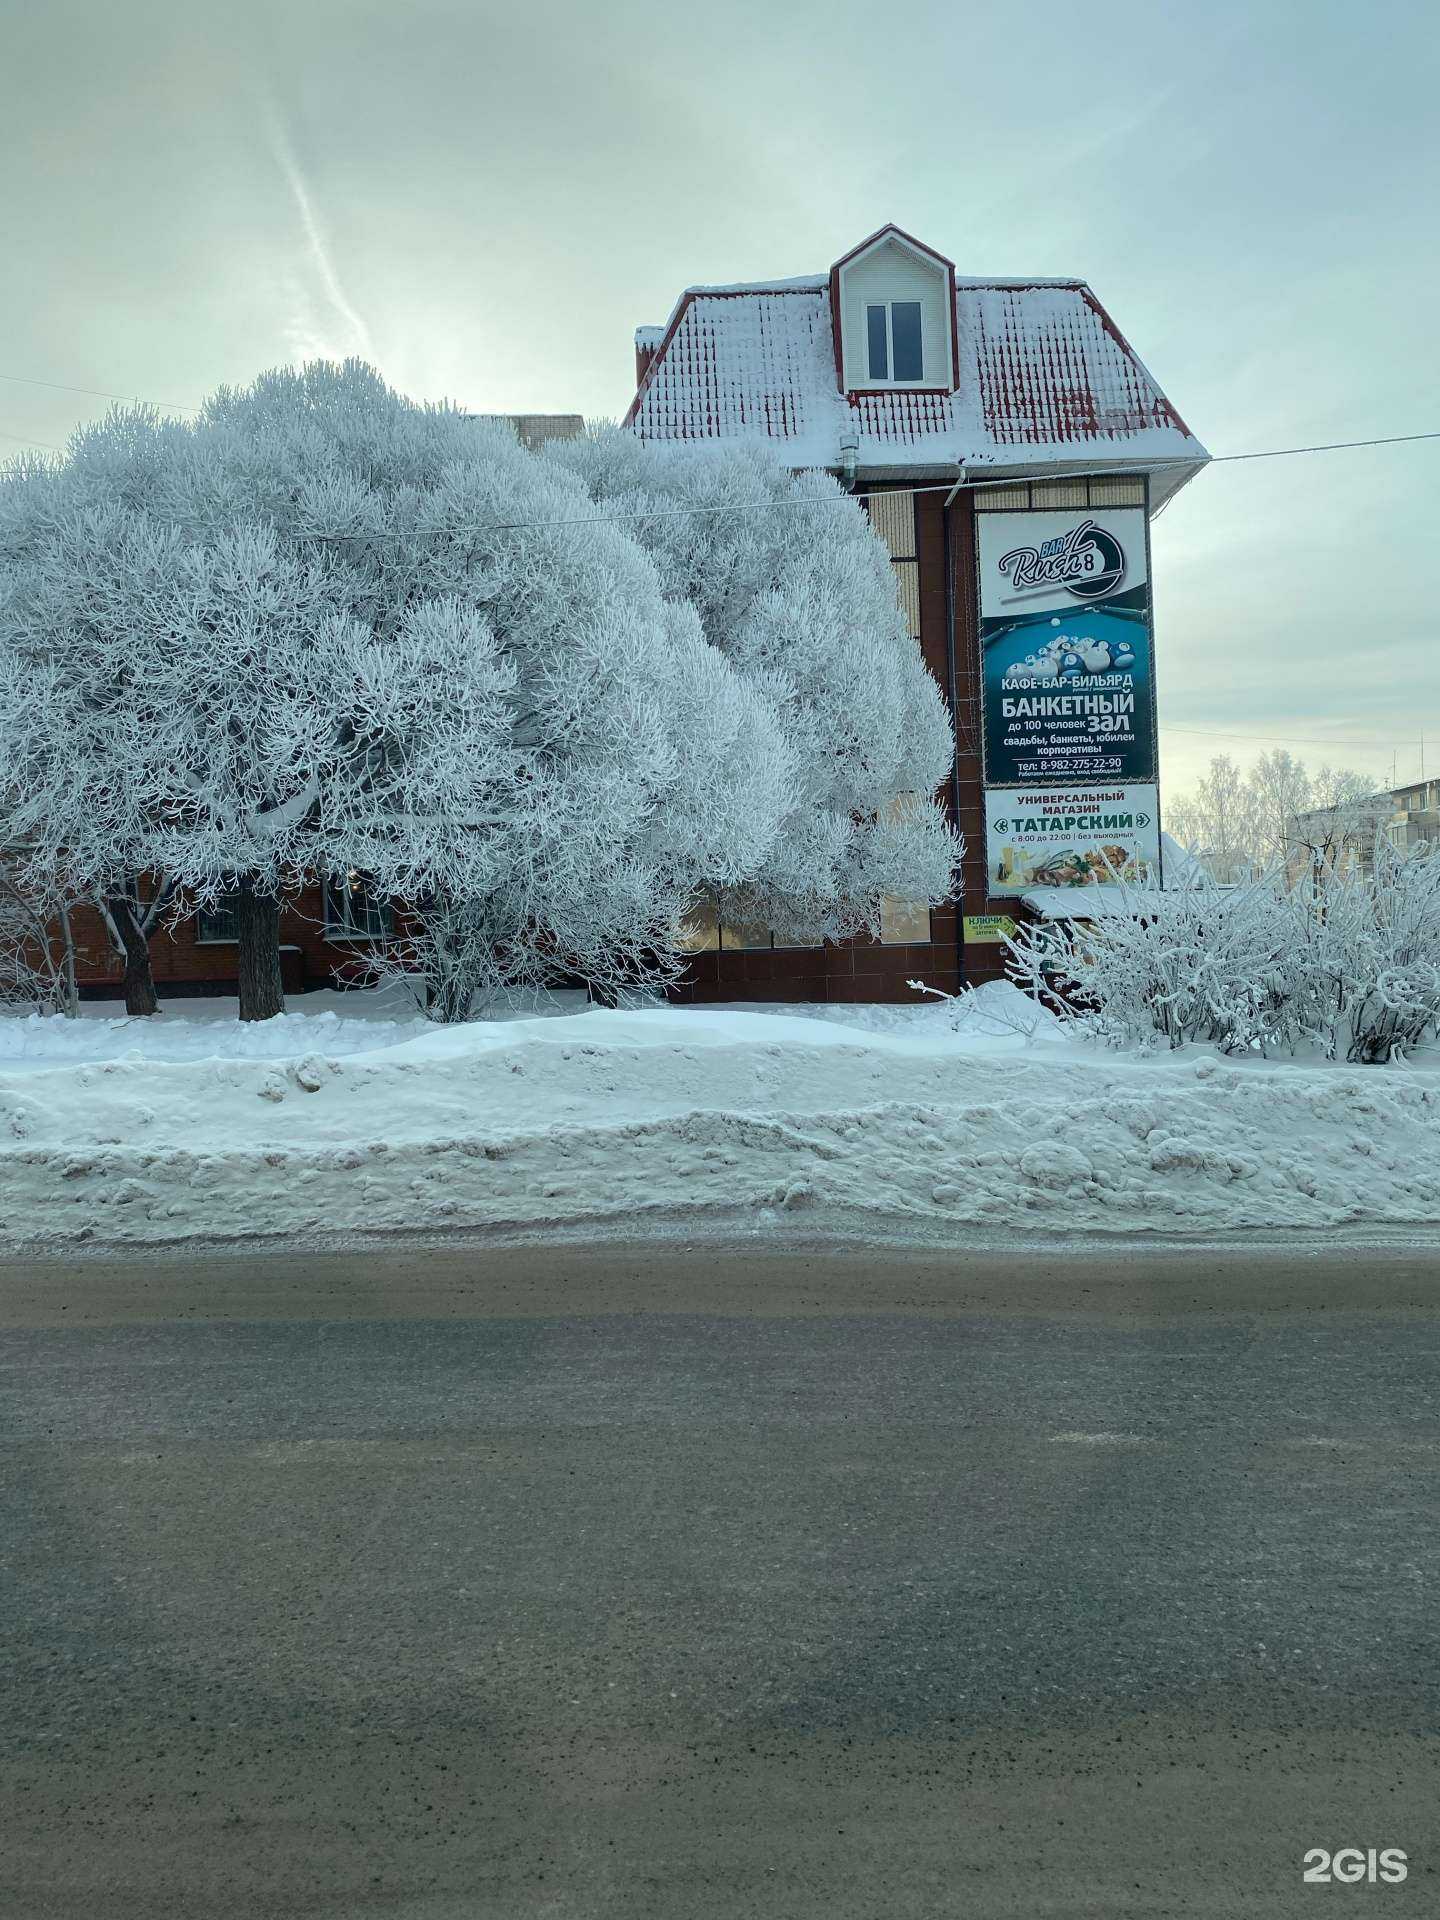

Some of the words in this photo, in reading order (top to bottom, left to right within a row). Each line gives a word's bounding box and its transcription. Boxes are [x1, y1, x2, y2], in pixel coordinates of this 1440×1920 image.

[1040, 537, 1064, 559] BAR
[1001, 674, 1133, 689] КАФЕ-БАР-БИЛЬЯРД
[1002, 689, 1134, 718] БАНКЕТНЫЙ
[1008, 722, 1021, 732] до
[1024, 720, 1041, 730] 100
[1045, 720, 1086, 729] человек
[1003, 735, 1048, 747] свадьбы,
[1050, 734, 1094, 744] банкеты,
[1037, 746, 1102, 757] корпоративы
[1018, 763, 1037, 771] тел:
[1040, 758, 1122, 770] 8-982-275-22-90
[1016, 790, 1125, 804] УНИВЕРСАЛЬНЫЙ
[1042, 805, 1100, 815] МАГАЗИН
[1011, 812, 1133, 832] ТАТАРСКИЙ
[1078, 832, 1092, 840] без
[968, 916, 1002, 925] КЛЮЧИ
